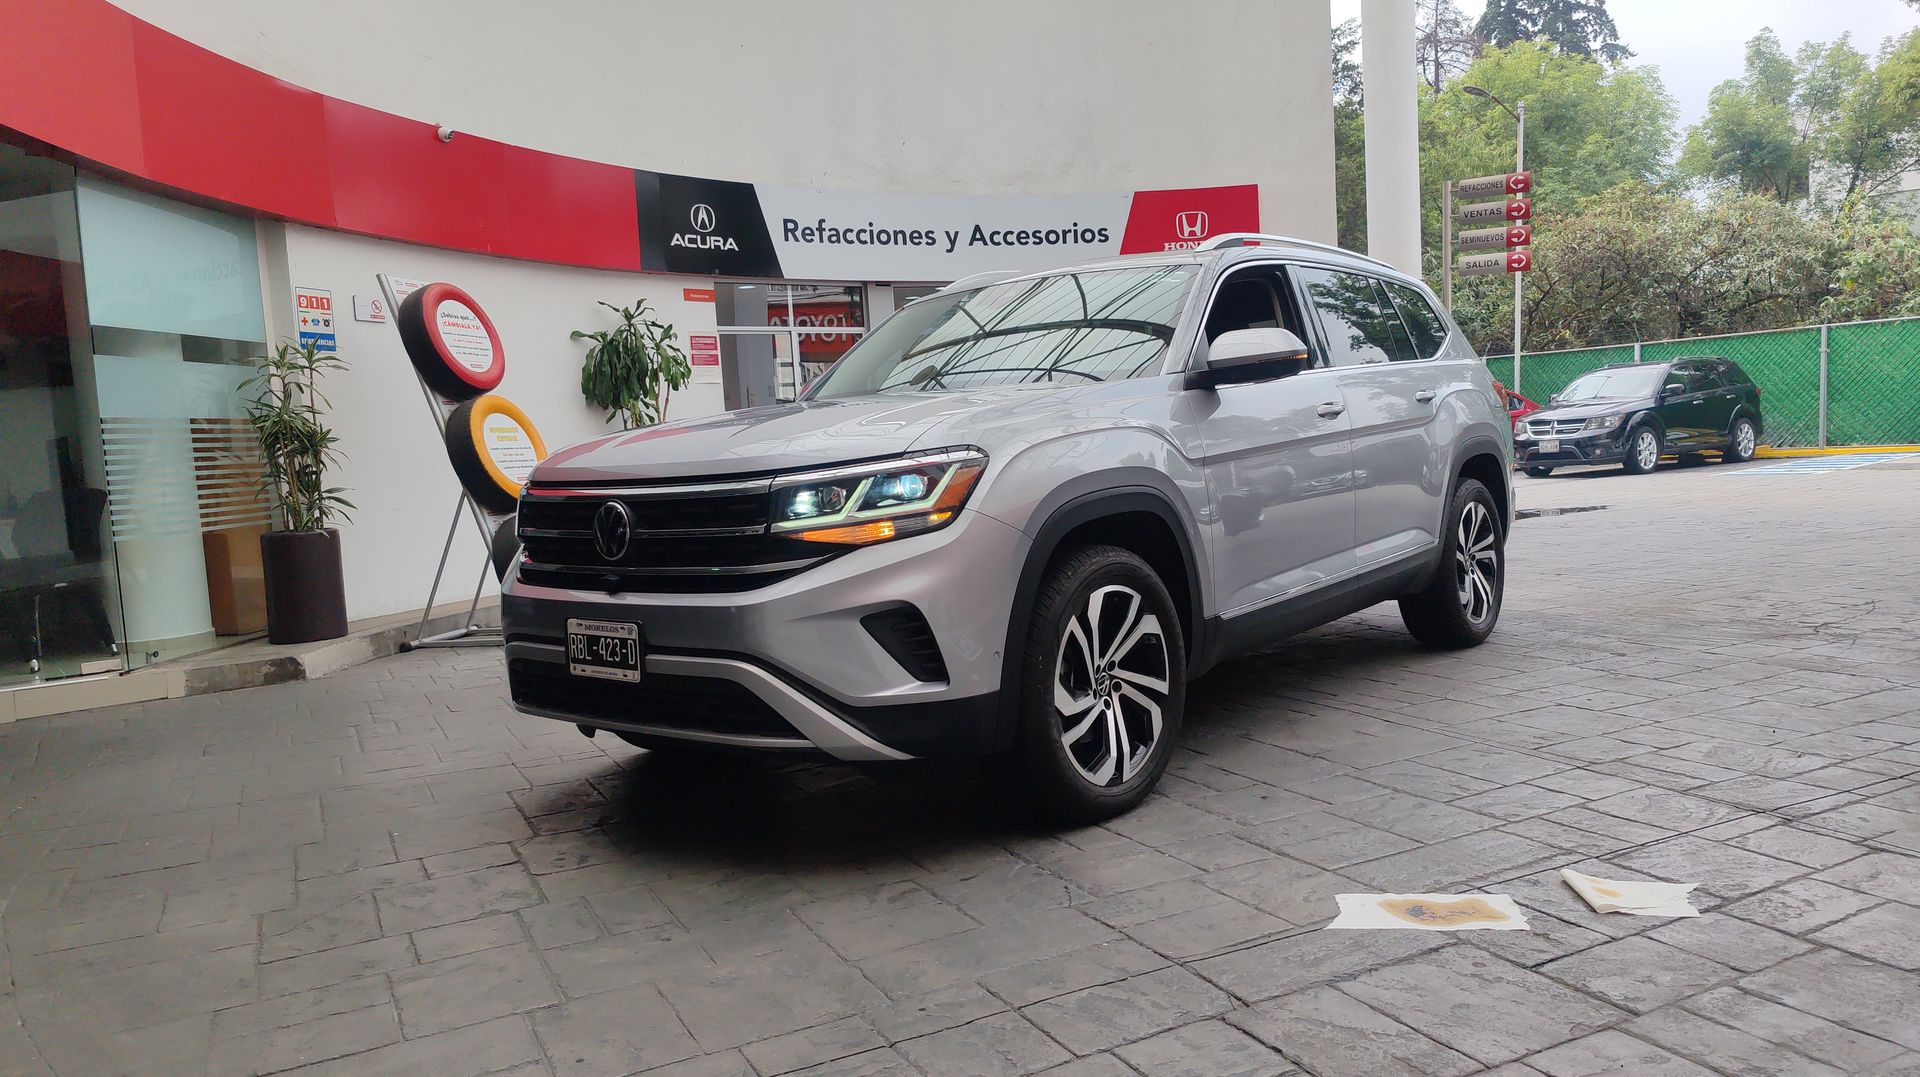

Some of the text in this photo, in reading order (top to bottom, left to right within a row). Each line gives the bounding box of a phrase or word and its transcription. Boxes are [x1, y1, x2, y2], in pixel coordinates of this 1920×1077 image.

[1460, 181, 1504, 193] REFACCIONES
[1464, 207, 1502, 218] VENTAS
[670, 233, 739, 251] ACURA
[782, 218, 1110, 254] Refacciones y Accesorios
[1460, 233, 1505, 245] SEMINUEVOS
[1163, 241, 1203, 251] HON
[1465, 260, 1500, 270] SALIDA
[299, 295, 329, 309] 911
[584, 624, 620, 633] MORELOS
[570, 634, 636, 665] RBL-423-D
